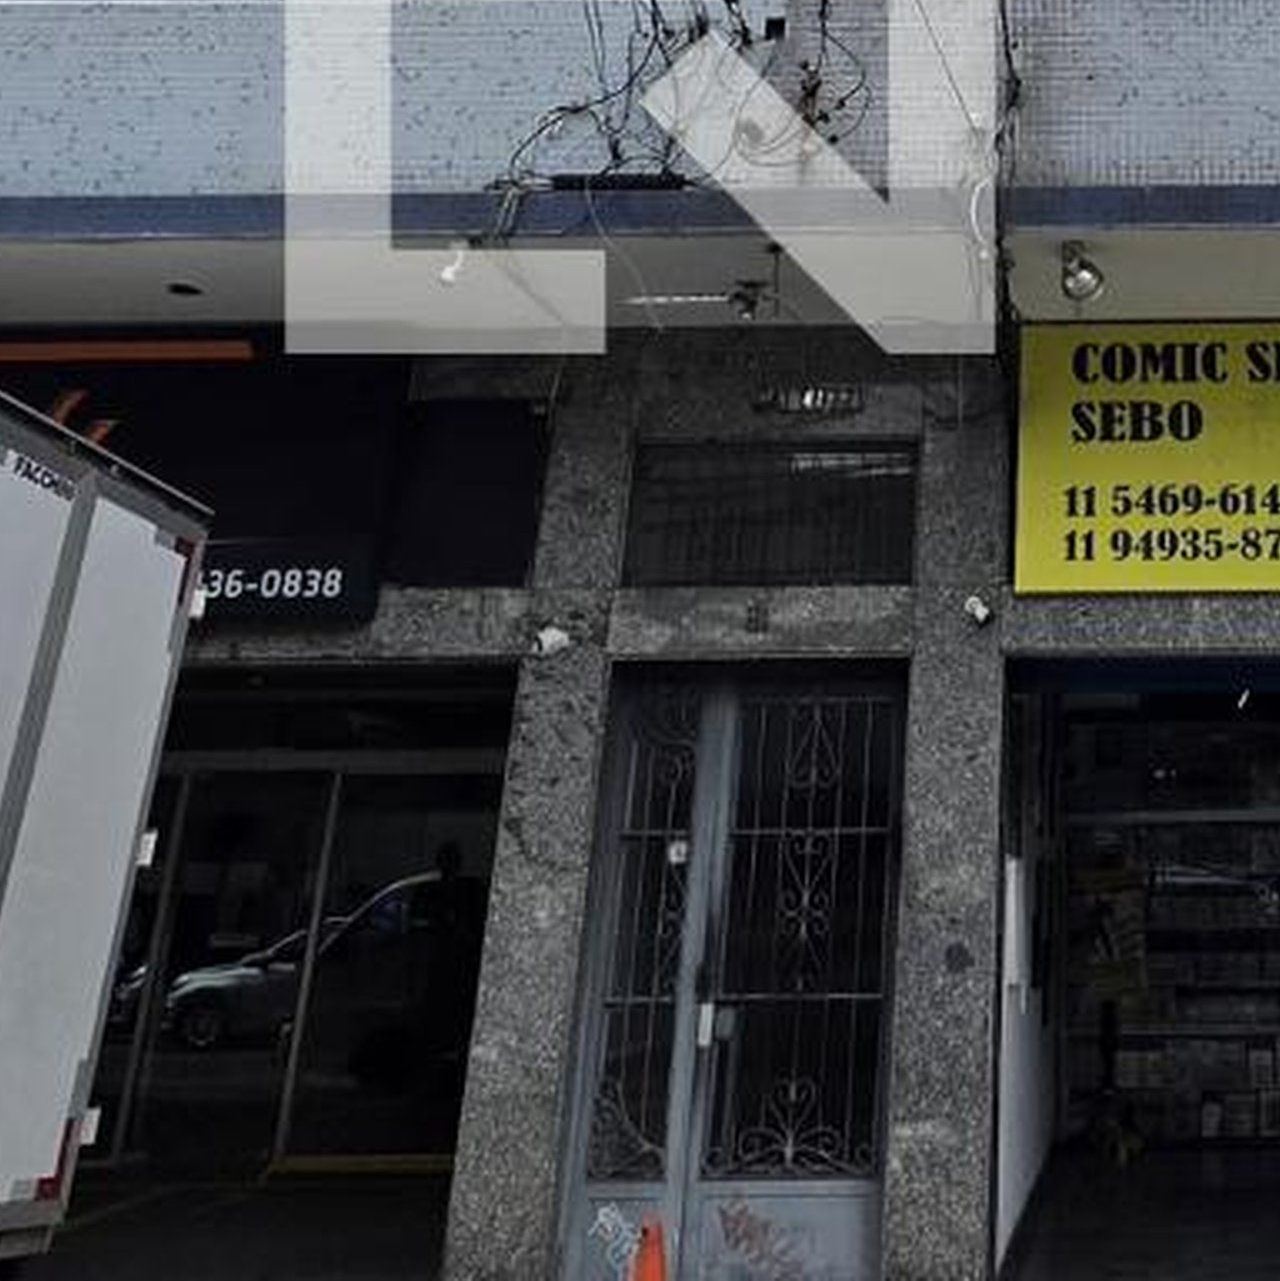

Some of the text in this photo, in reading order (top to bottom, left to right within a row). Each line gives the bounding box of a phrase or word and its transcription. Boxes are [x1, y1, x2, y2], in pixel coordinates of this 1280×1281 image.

[1073, 341, 1228, 384] COMIC
[1071, 400, 1204, 443] SEBO
[1064, 485, 1097, 517] 11
[1064, 529, 1095, 561] 11
[197, 569, 342, 598] 36-0838
